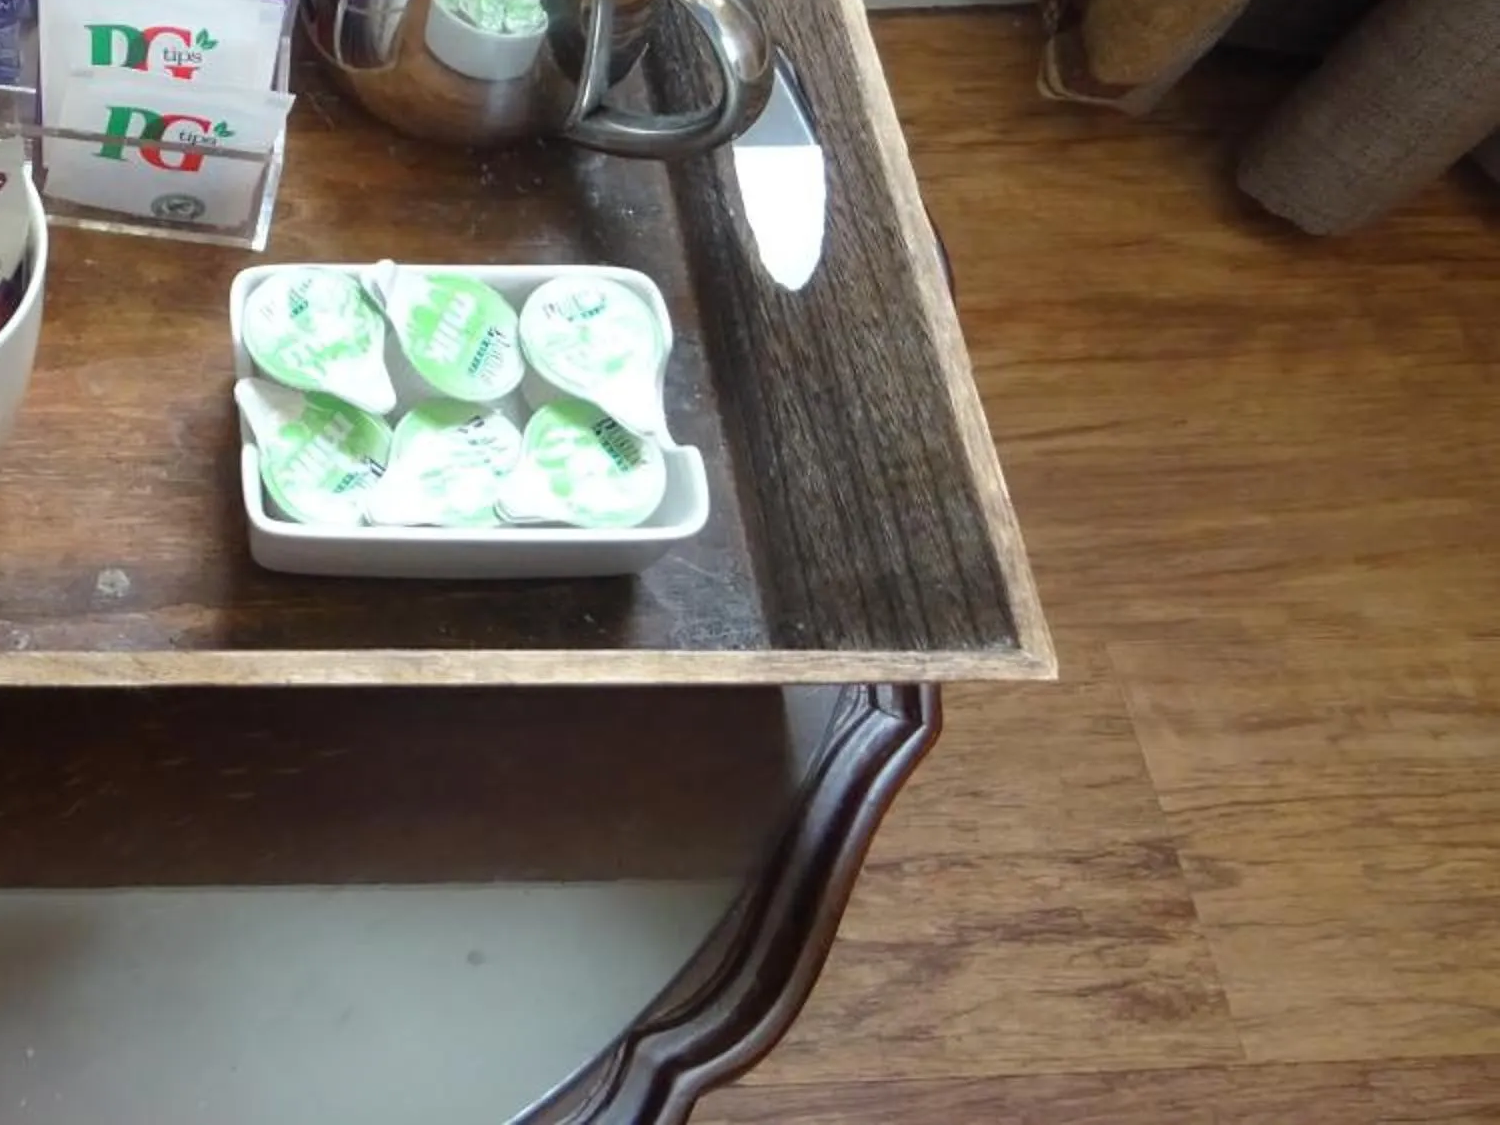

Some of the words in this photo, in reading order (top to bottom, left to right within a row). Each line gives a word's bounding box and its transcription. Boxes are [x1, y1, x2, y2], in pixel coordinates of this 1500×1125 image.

[83, 23, 193, 80] PG
[162, 47, 203, 65] tips
[92, 105, 213, 173] PG
